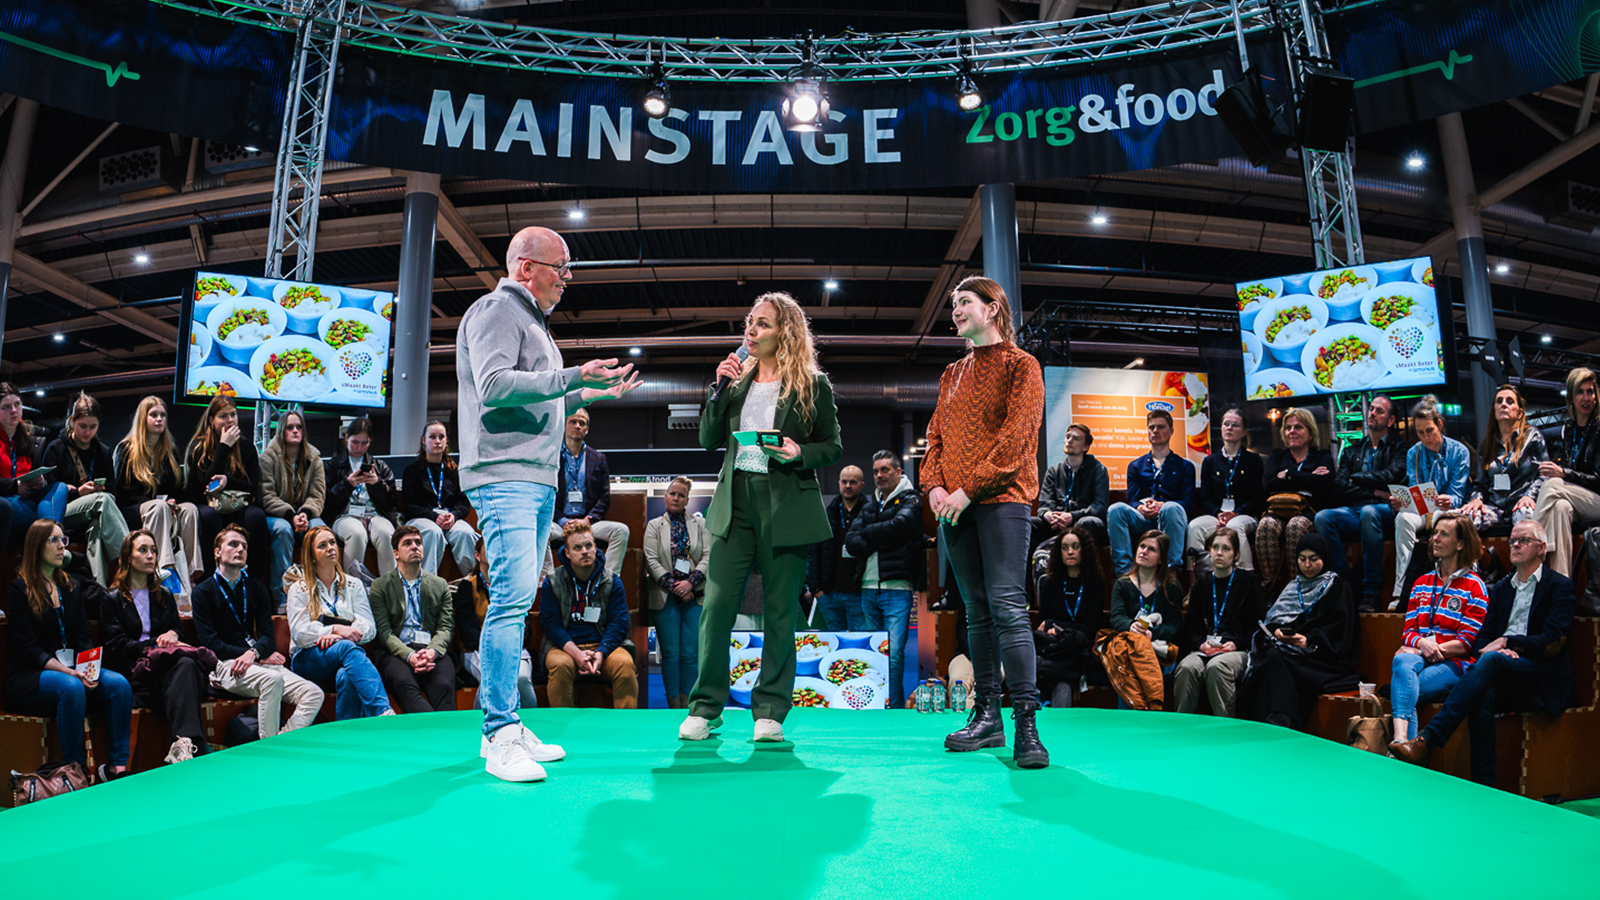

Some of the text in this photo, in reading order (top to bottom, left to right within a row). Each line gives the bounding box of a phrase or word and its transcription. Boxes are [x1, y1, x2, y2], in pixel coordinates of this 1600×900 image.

[422, 89, 902, 166] MAINSTAGE
[964, 69, 1226, 147] Zorg&food
[1134, 427, 1148, 435] inspi
